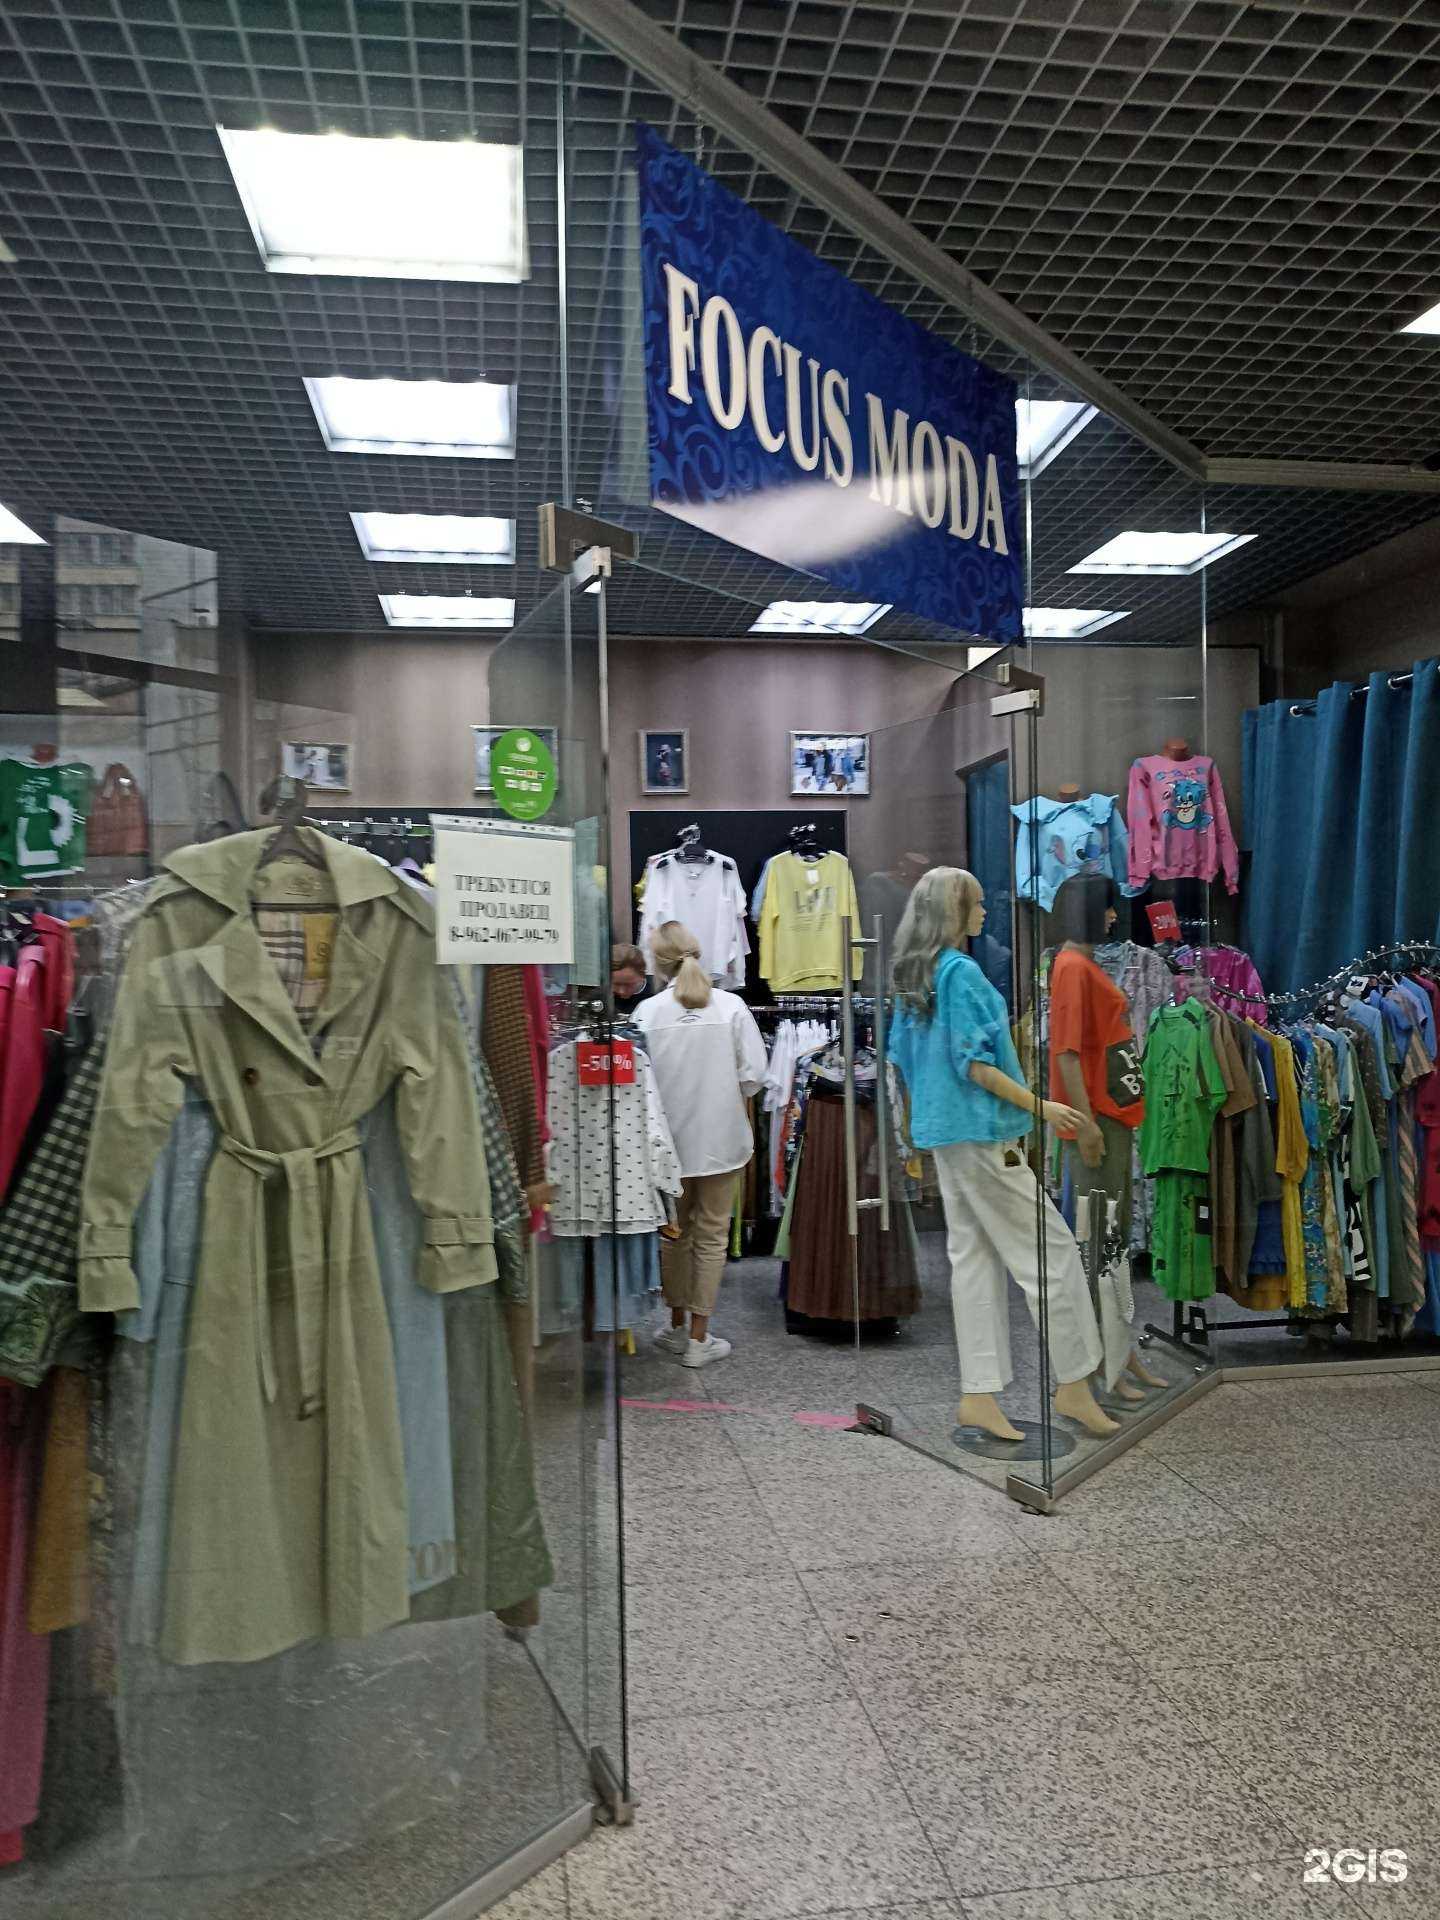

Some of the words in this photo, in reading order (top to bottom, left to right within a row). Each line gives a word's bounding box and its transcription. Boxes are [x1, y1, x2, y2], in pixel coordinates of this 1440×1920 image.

[663, 263, 854, 487] FOCUS
[866, 392, 1009, 555] MODA
[453, 874, 552, 896] ТРЕБУЕТСЯ
[458, 900, 551, 920] ПРОДАВЕЦ
